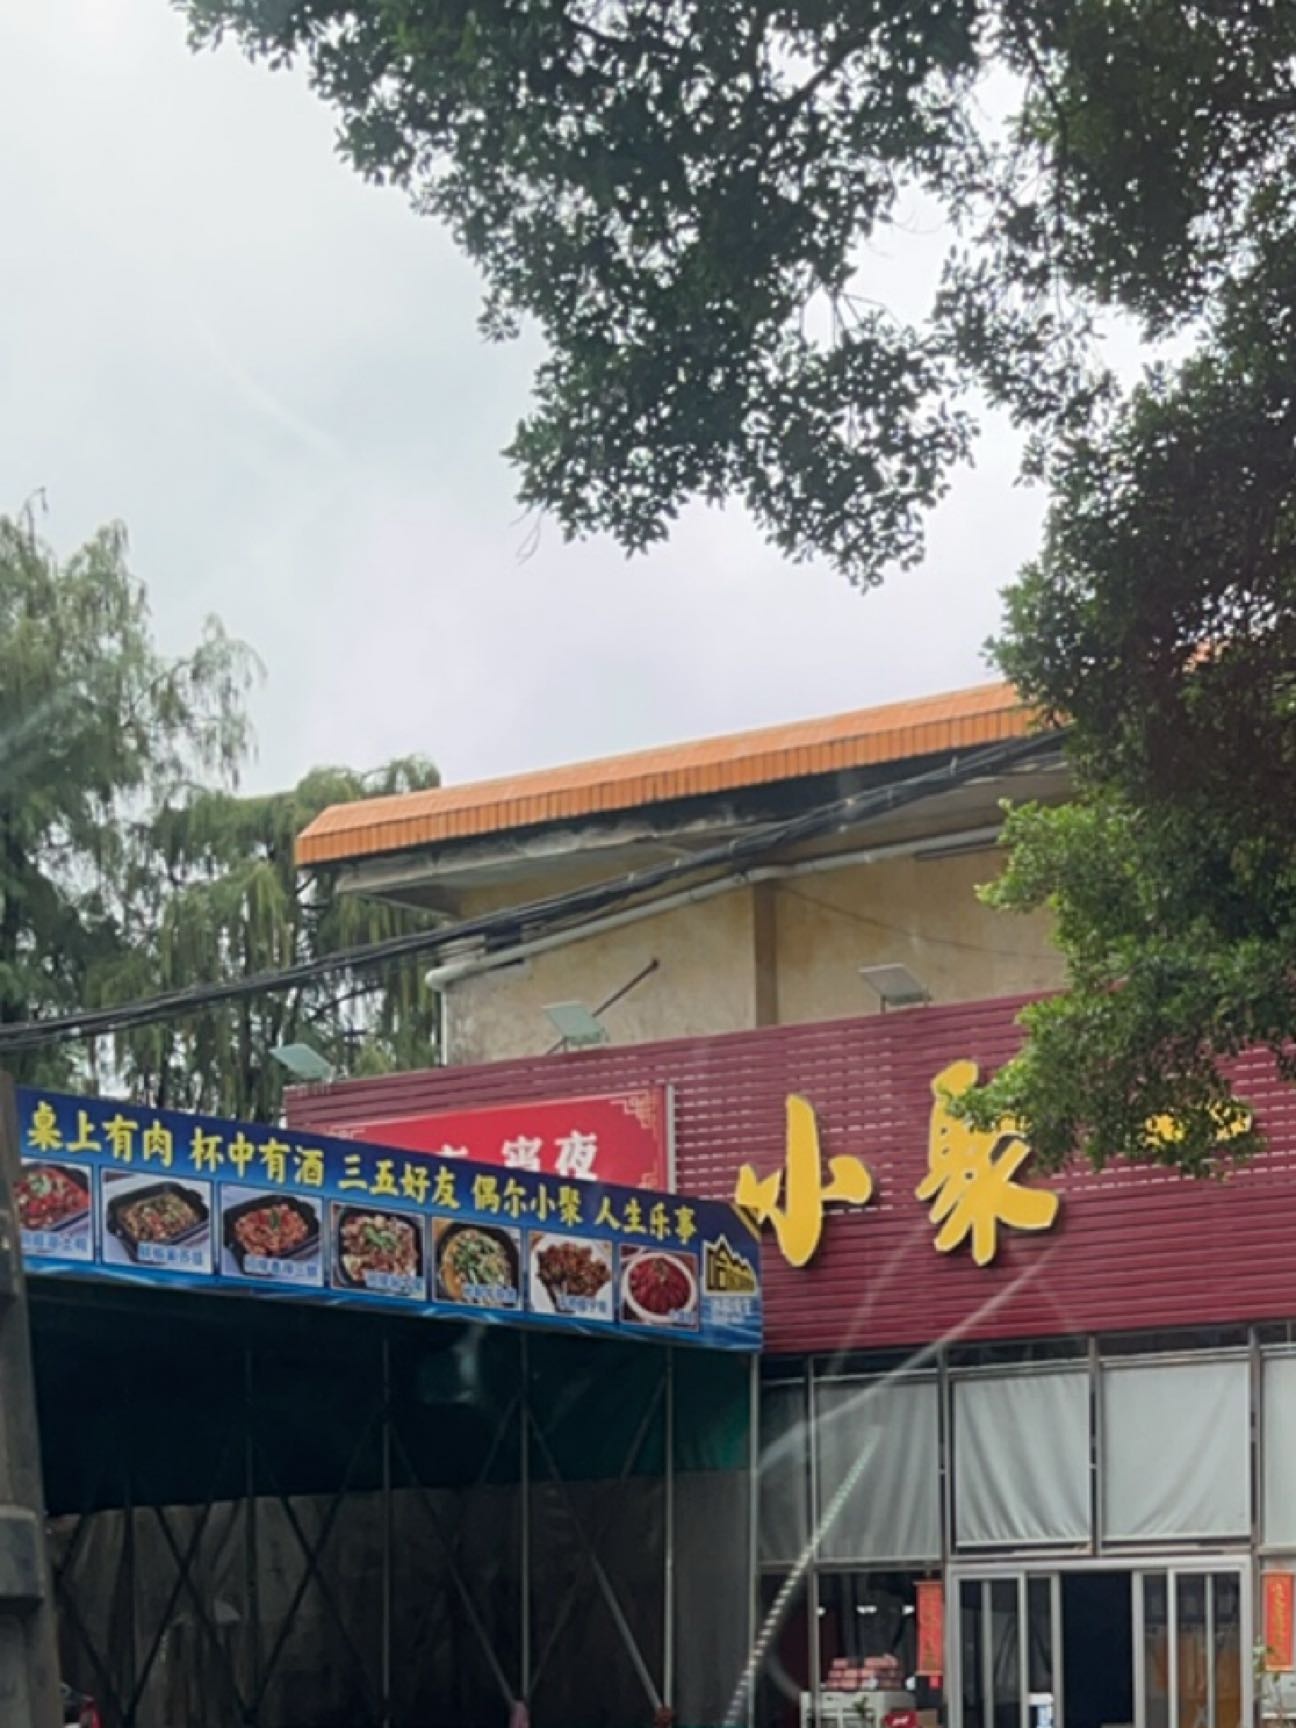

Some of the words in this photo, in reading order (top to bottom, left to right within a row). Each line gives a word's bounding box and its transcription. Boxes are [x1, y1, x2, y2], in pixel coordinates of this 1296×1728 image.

[27, 1100, 175, 1168] 桌上有肉
[189, 1126, 325, 1188] 杯中有酒
[337, 1153, 460, 1210] 三五好友
[470, 1173, 583, 1228] 偶尔小聚
[594, 1196, 698, 1245] 人生乐事
